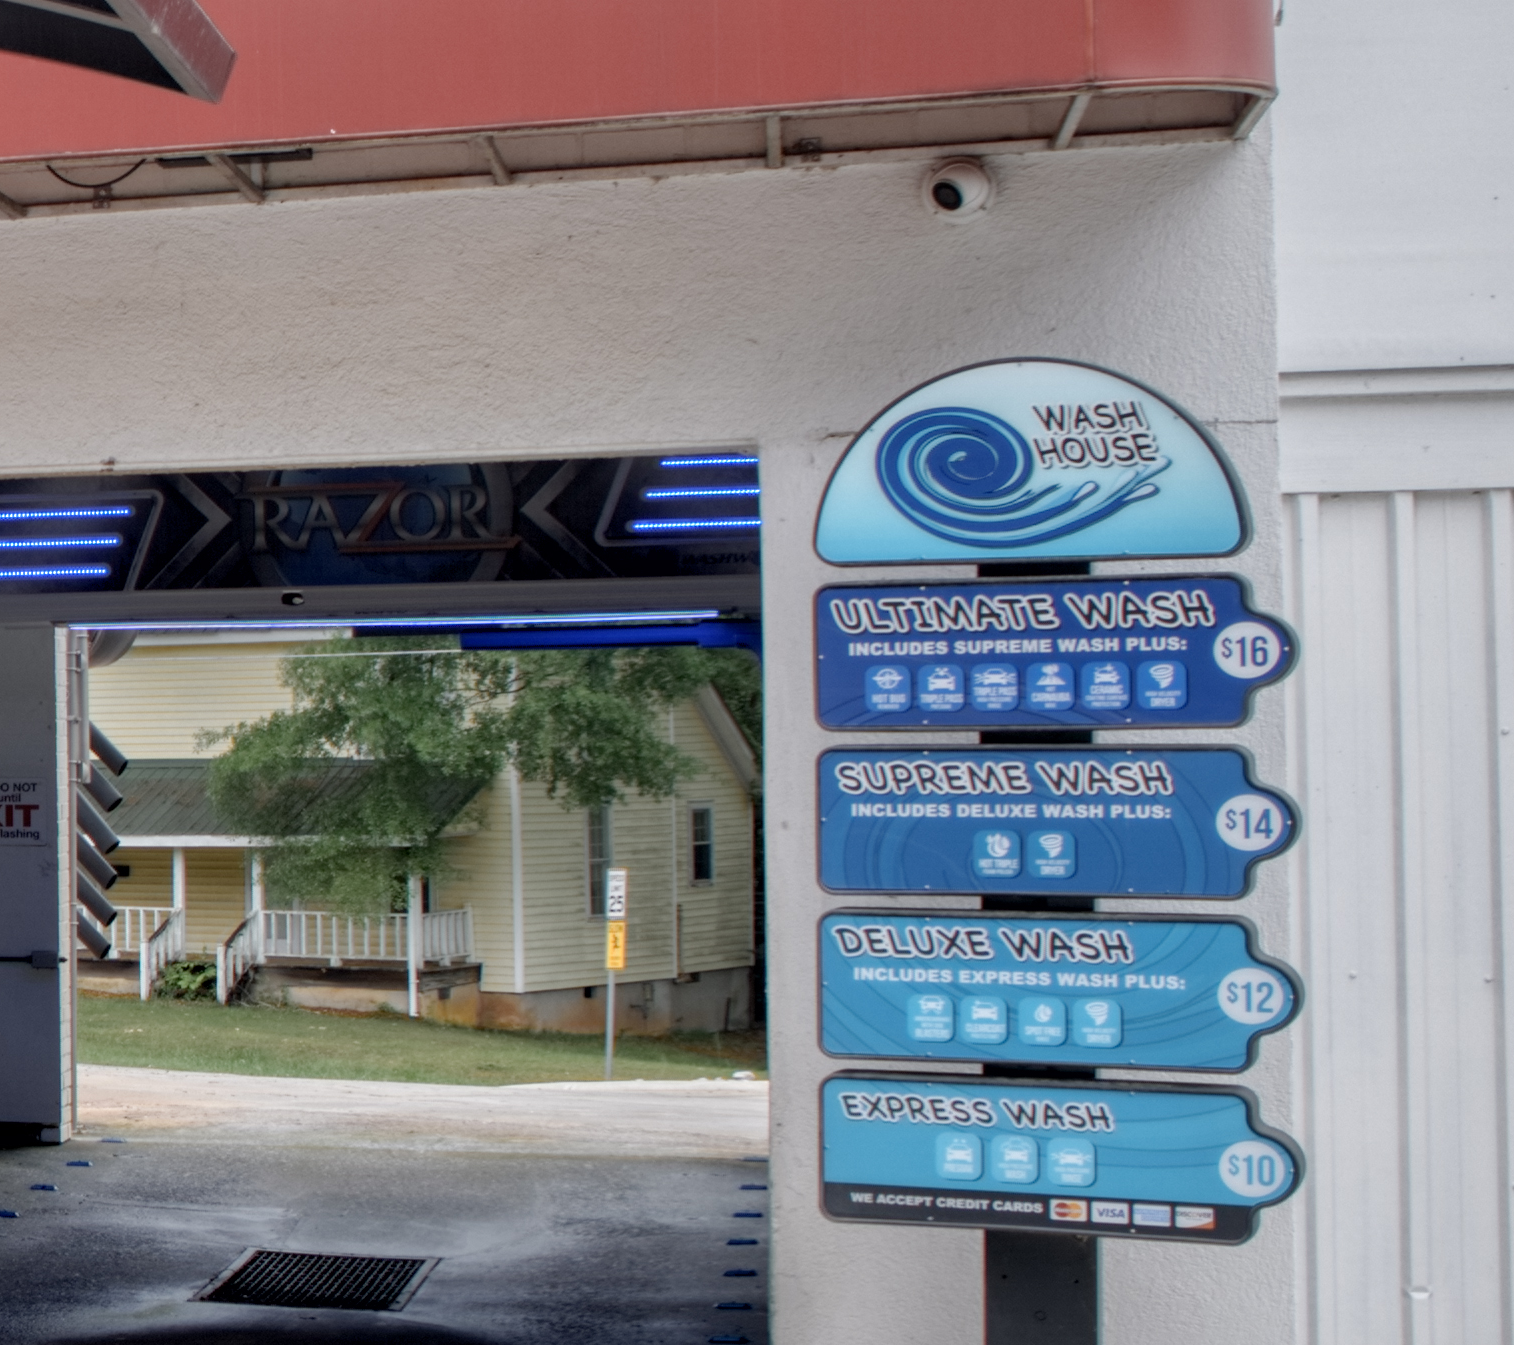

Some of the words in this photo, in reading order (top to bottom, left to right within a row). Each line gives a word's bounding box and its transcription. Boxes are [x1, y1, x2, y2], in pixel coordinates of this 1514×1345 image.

[1033, 402, 1143, 432] WASH
[1033, 434, 1158, 466] HOUSE
[235, 482, 522, 552] RAZOR
[830, 593, 1061, 633] ULTIMATE
[1064, 590, 1217, 630] WASH
[848, 641, 950, 657] INCLUDES
[954, 640, 1053, 655] SUPREME
[1057, 638, 1122, 652] WASH
[1126, 636, 1188, 652] PLUS:
[1221, 636, 1268, 668] $16
[13, 782, 37, 792] NOT
[836, 760, 1032, 796] SUPREME
[1036, 760, 1174, 796] WASH
[852, 804, 951, 818] INCLUDES
[958, 804, 1037, 819] DELUXE
[1043, 804, 1105, 819] WASH
[1110, 805, 1172, 820] PLUS:
[1226, 808, 1274, 840] $14
[609, 895, 624, 912] 25
[833, 926, 992, 960] DELUXE
[998, 928, 1133, 963] WASH
[854, 968, 953, 984] INCLUDES
[959, 970, 1051, 986] EXPRESS
[1057, 973, 1120, 988] WASH
[1125, 974, 1186, 990] PLUS:
[1227, 980, 1275, 1014] $12
[839, 1093, 996, 1126] EXPRESS
[1001, 1100, 1114, 1132] WASH
[1228, 1154, 1276, 1187] $10
[850, 1193, 874, 1203] WE
[876, 1193, 933, 1207] ACCEPT
[935, 1196, 990, 1210] CREDIT
[992, 1200, 1043, 1214] CARDS
[1096, 1207, 1125, 1219] VISA
